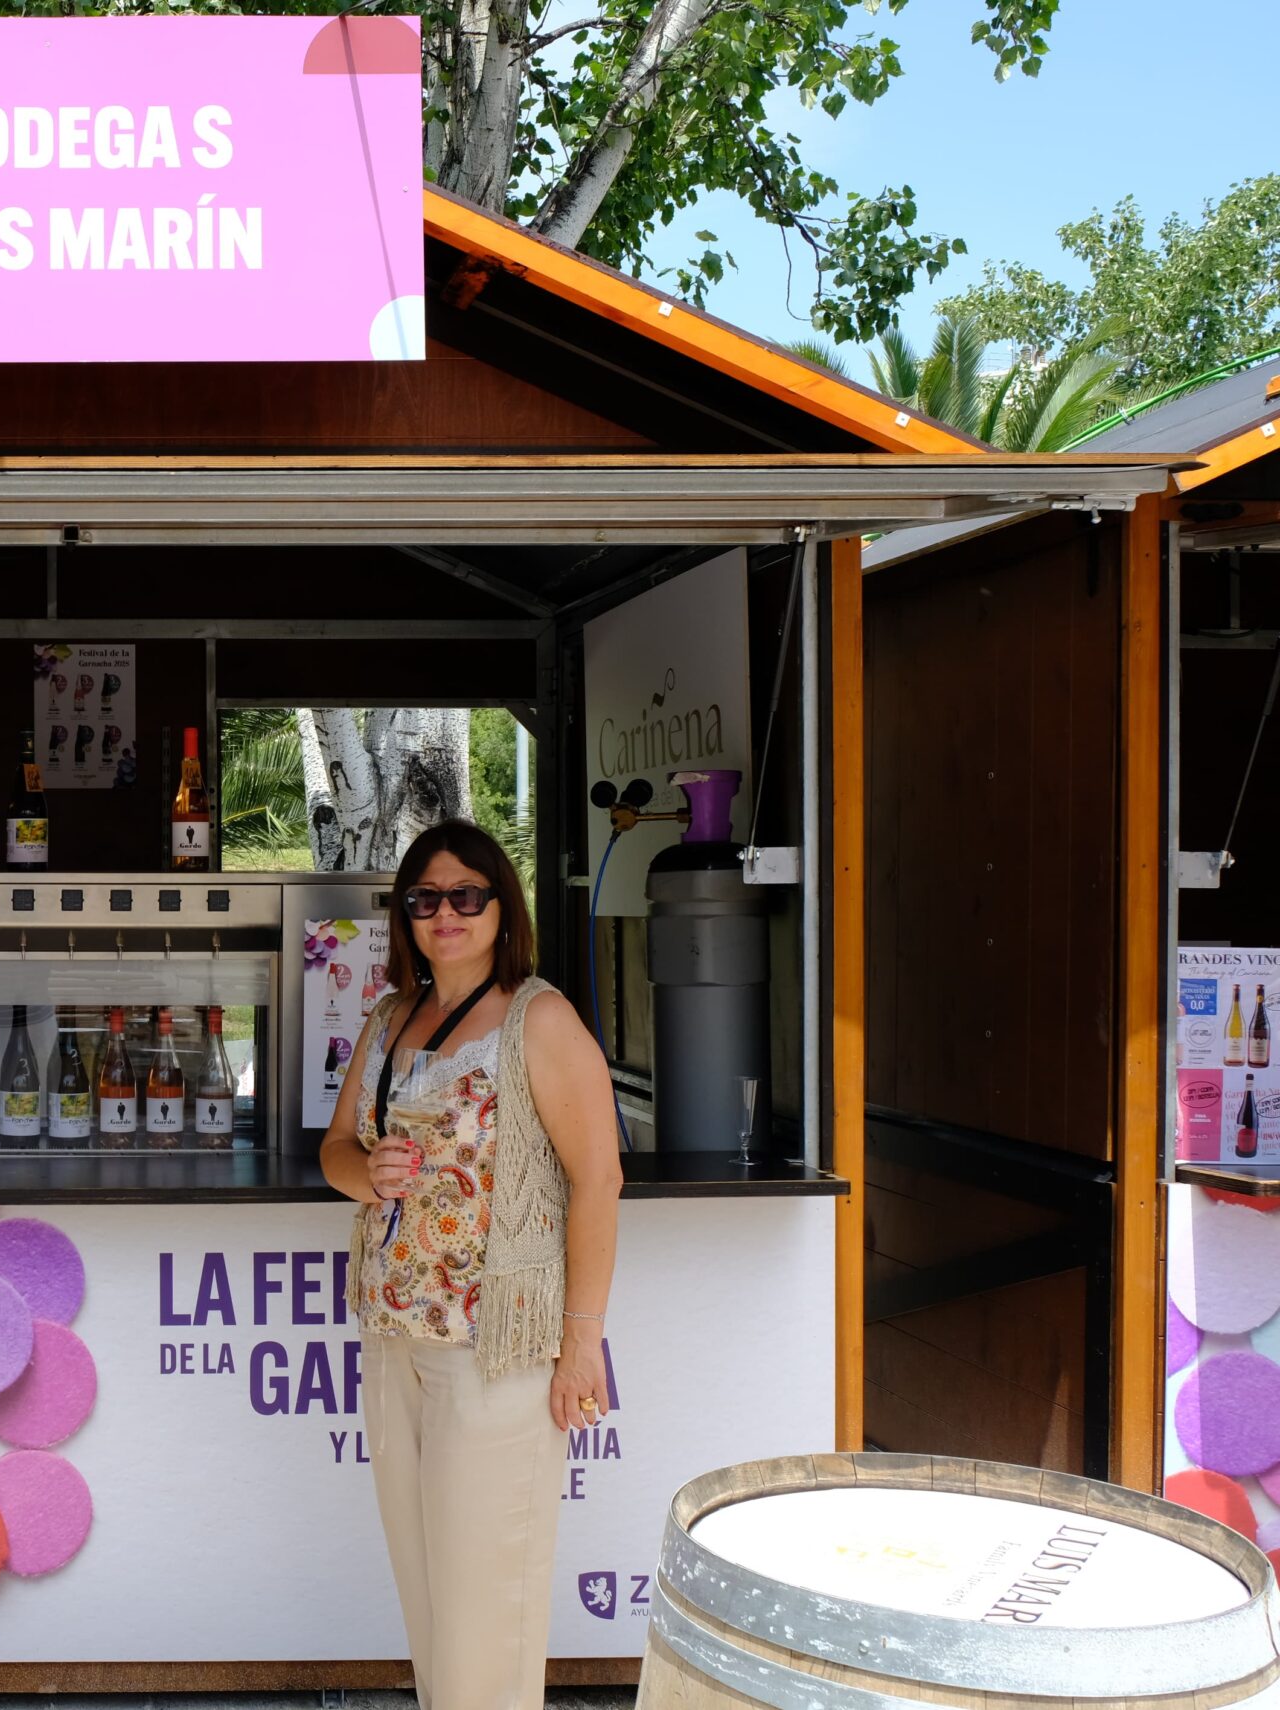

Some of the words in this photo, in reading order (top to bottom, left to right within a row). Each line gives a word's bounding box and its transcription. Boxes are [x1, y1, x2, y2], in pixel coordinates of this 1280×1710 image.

[49, 193, 263, 271] MARÍN
[599, 668, 724, 778] Cariñena
[1178, 953, 1242, 965] RANDES
[159, 1252, 237, 1326] LA
[160, 1343, 194, 1375] DE
[202, 1343, 236, 1375] LA
[329, 1431, 347, 1464] Y
[1032, 1524, 1108, 1574] LUIS
[980, 1572, 1071, 1624] MAR
